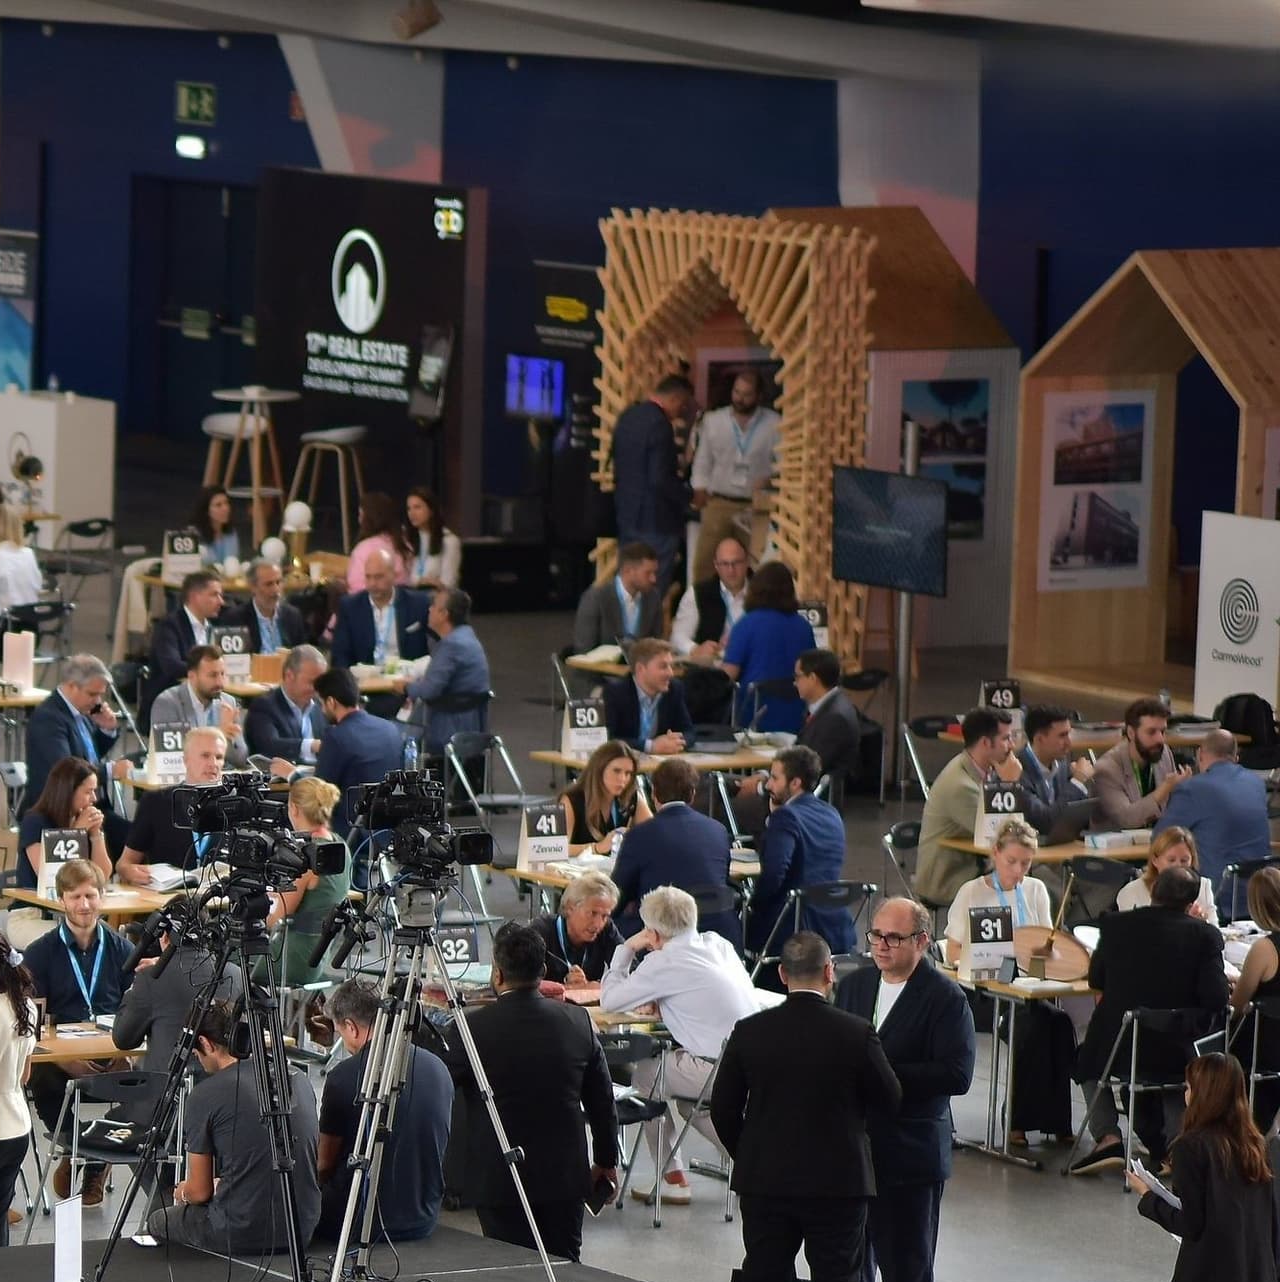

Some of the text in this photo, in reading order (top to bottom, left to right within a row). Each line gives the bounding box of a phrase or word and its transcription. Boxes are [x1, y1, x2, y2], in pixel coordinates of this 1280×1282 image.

[361, 339, 409, 368] ESTATE
[173, 537, 193, 553] 69
[221, 635, 243, 654] 60
[991, 689, 1014, 708] 49
[576, 707, 598, 727] 50
[163, 731, 183, 750] 51
[991, 791, 1016, 811] 40
[536, 814, 557, 834] 41
[53, 839, 80, 859] 42
[980, 918, 1002, 940] 31
[442, 938, 470, 962] 32
